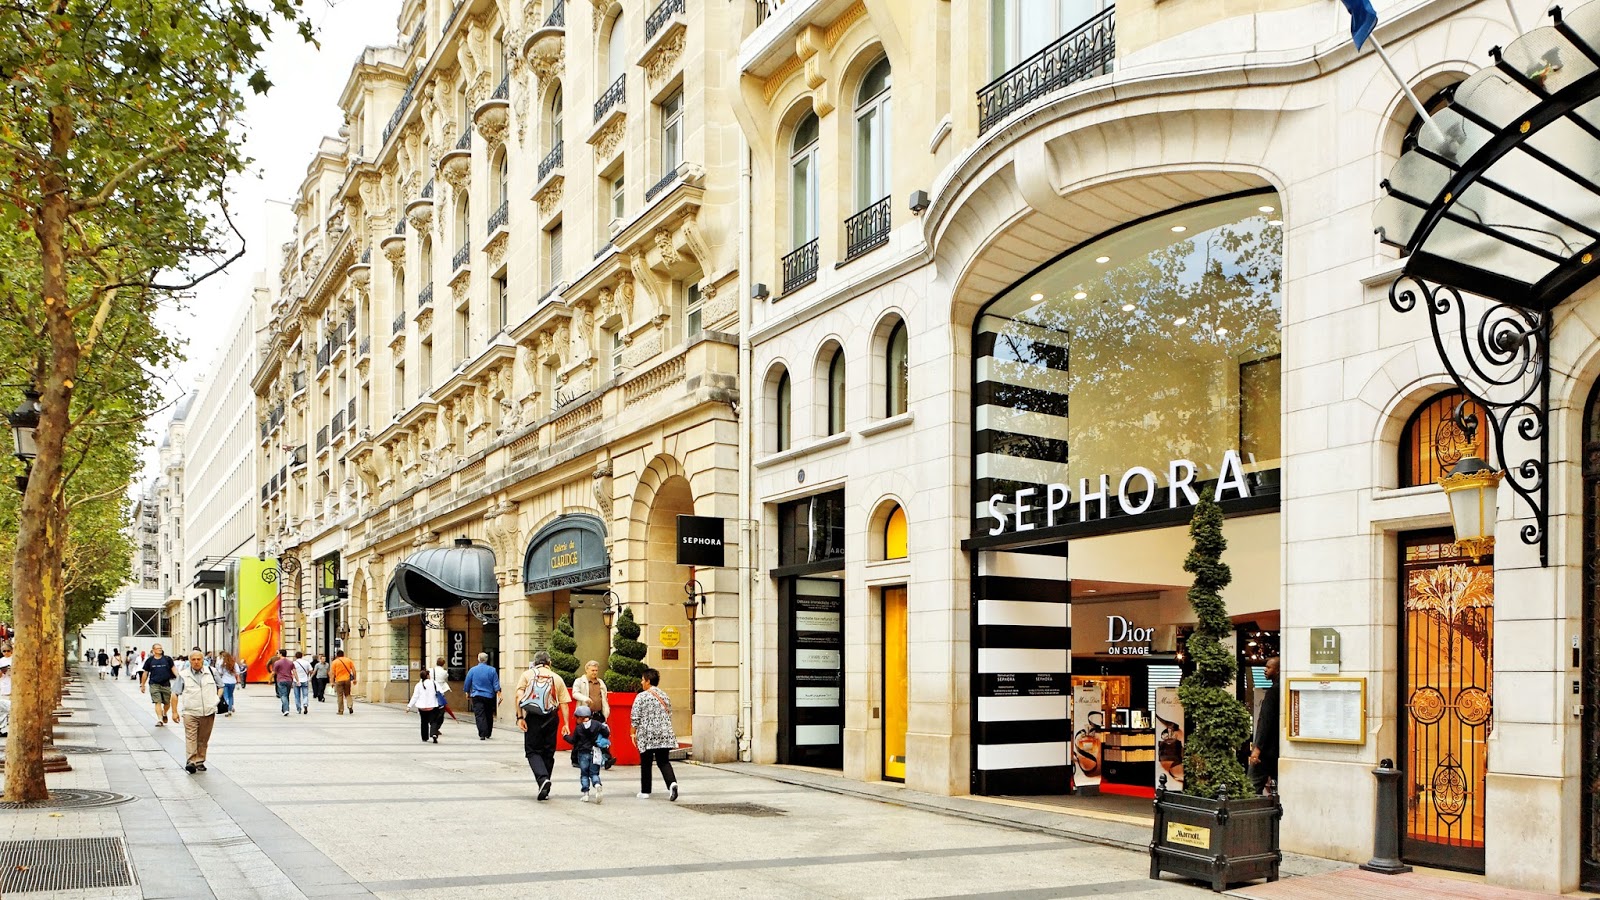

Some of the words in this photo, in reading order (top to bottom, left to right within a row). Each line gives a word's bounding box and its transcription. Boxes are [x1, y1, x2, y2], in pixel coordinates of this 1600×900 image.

[989, 449, 1250, 536] SEPHORA
[682, 536, 722, 546] SEPHORA
[551, 551, 578, 568] CLARIDGE
[1105, 615, 1155, 642] Dior
[451, 632, 463, 667] fnac
[1108, 646, 1120, 655] ON
[1122, 646, 1150, 655] STAGE
[1323, 635, 1336, 649] H
